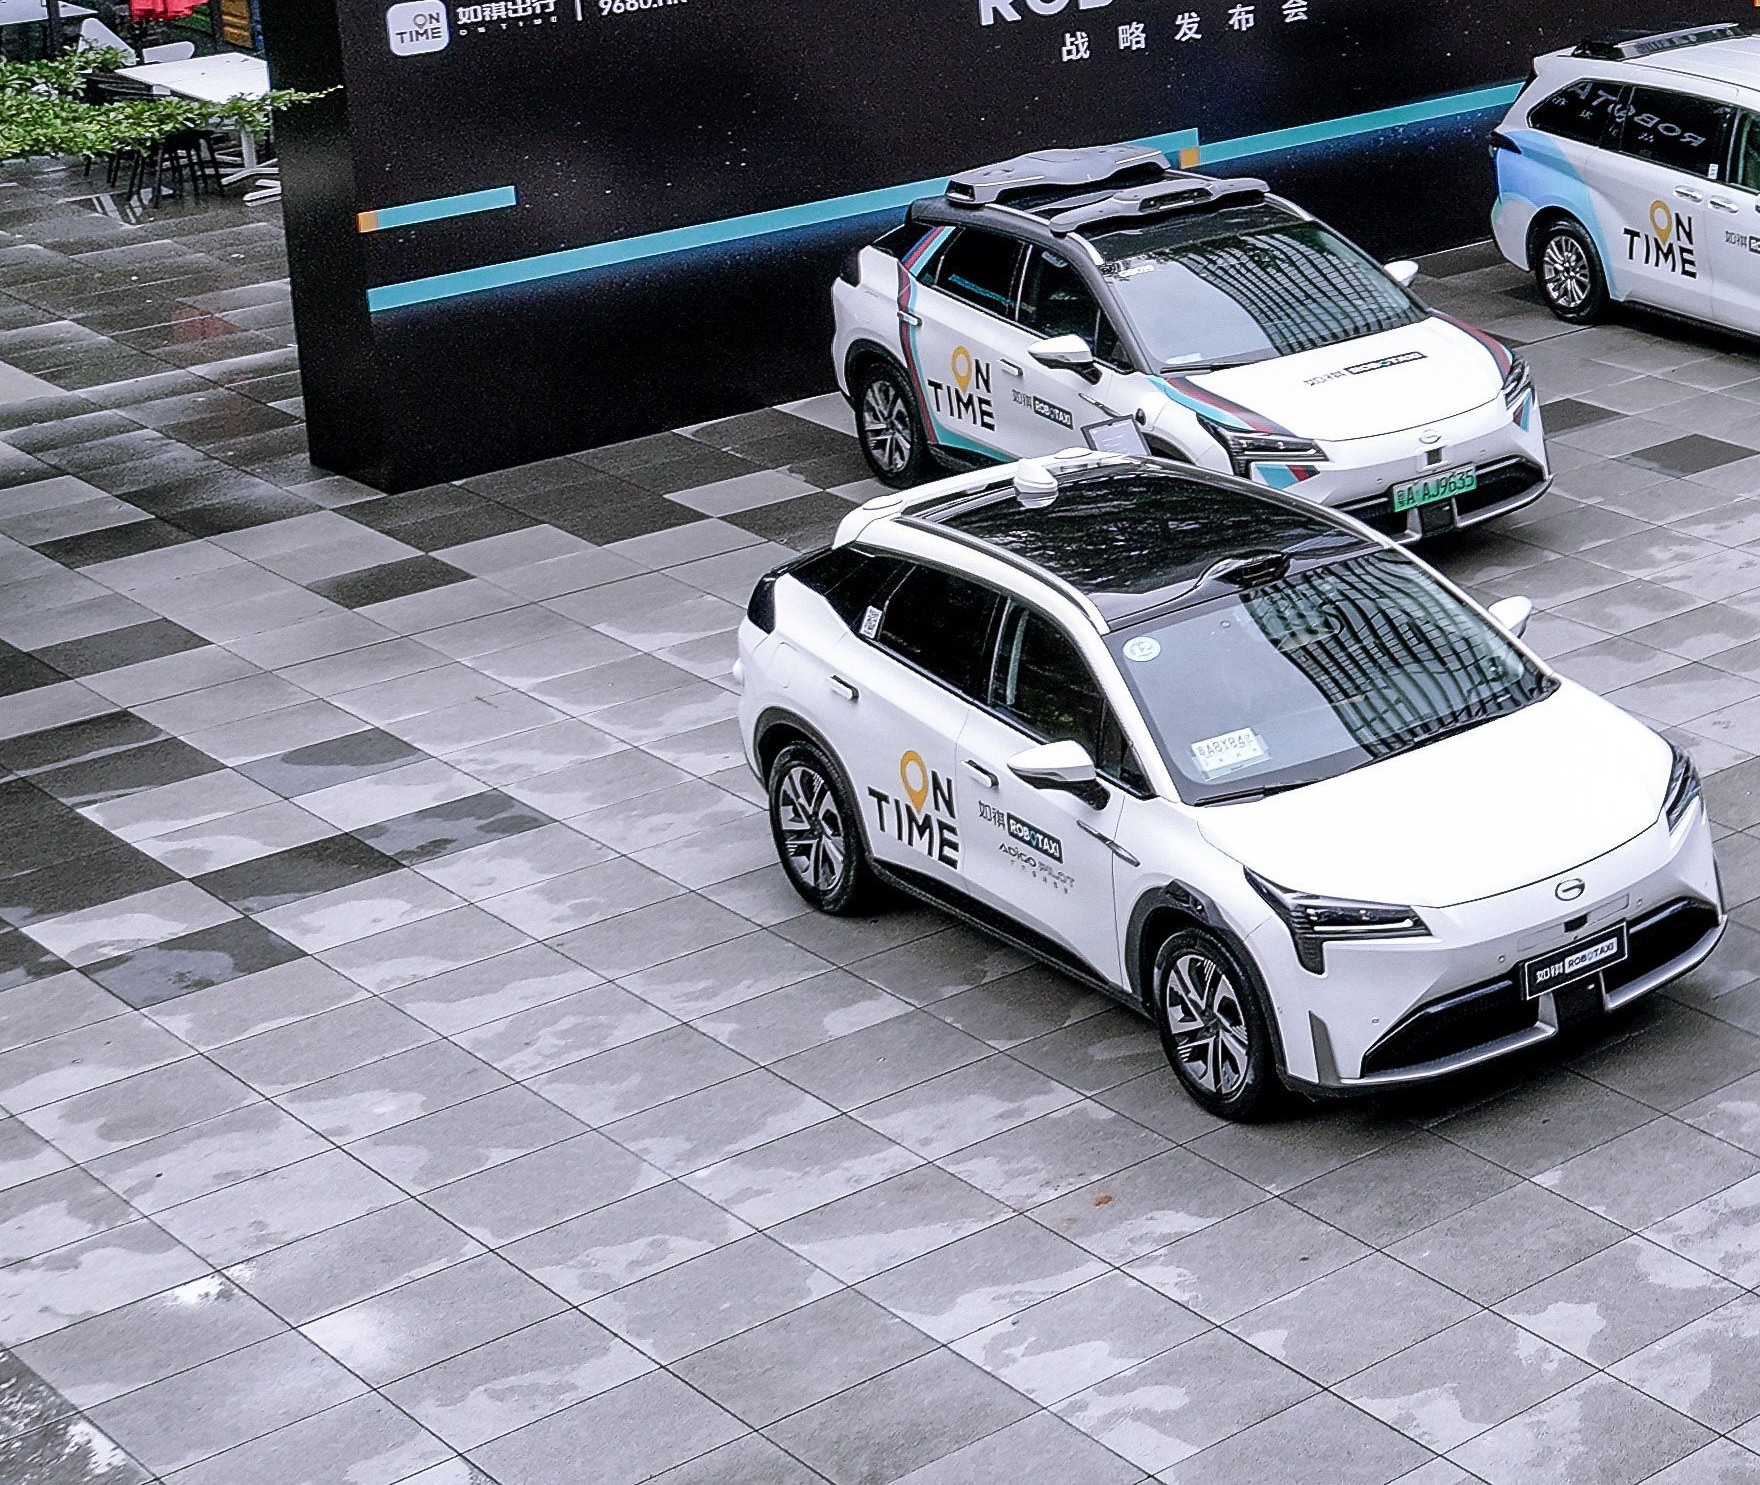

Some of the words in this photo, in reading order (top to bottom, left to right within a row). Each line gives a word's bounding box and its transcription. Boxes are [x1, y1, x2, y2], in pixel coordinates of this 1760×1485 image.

[395, 26, 442, 45] TIME
[412, 11, 442, 30] ON
[1650, 199, 1694, 245] ON
[1623, 227, 1697, 279] TIME
[951, 345, 992, 393] ON
[927, 378, 996, 432] TIME
[1034, 397, 1072, 427] ROBOTAXI
[900, 750, 956, 819] ON
[867, 786, 960, 870] TIME
[978, 800, 1006, 831] 如祺
[1009, 818, 1062, 858] ROBOTAXI
[1535, 962, 1564, 985] 如祺
[1567, 941, 1615, 969] ROBOTAXI
